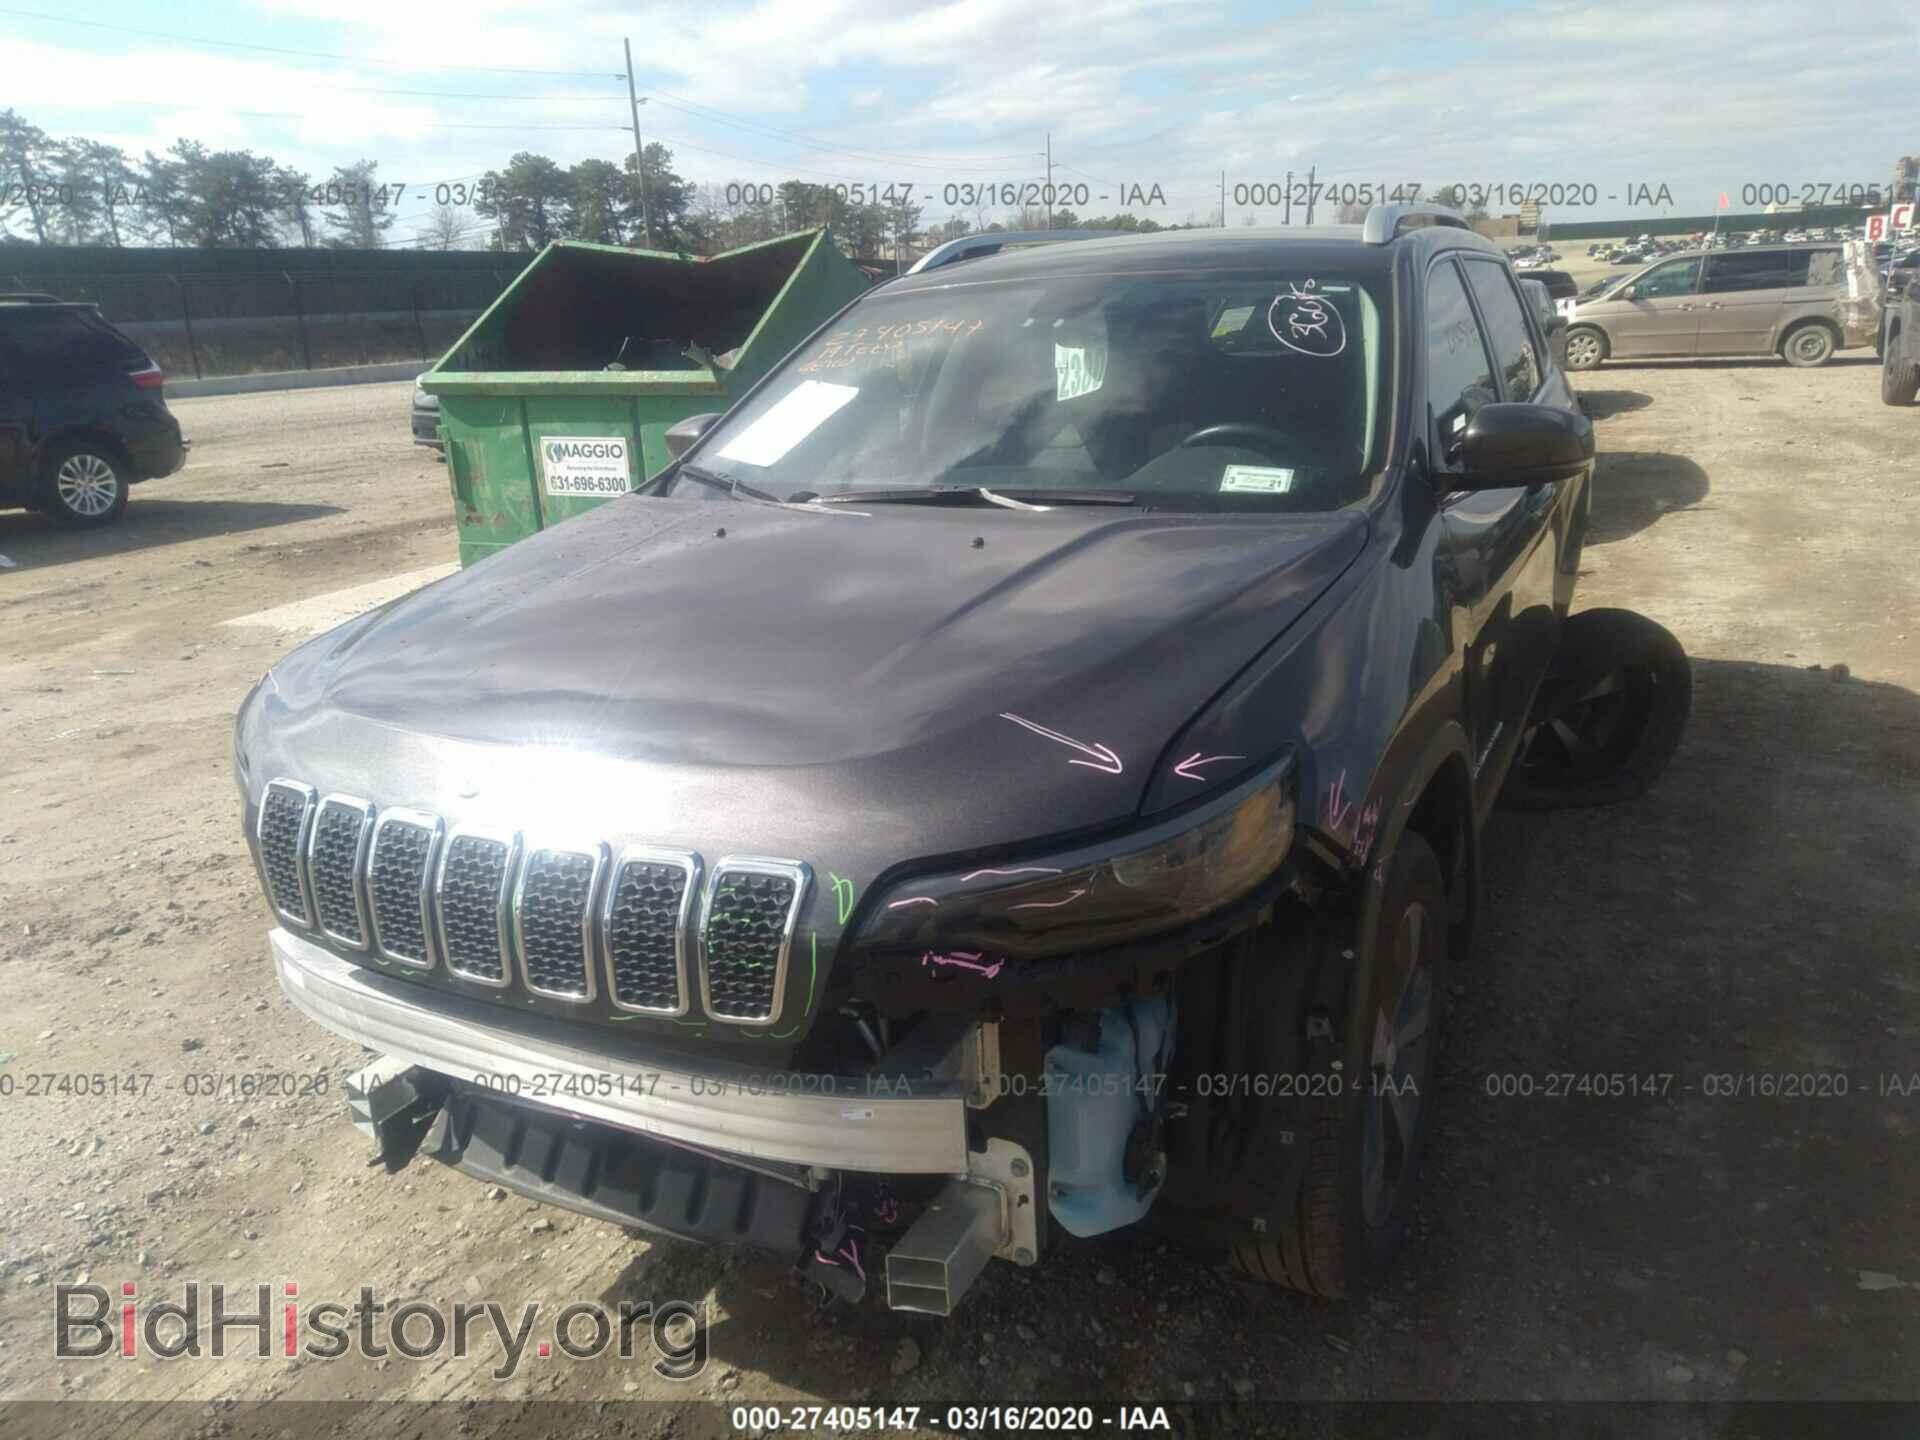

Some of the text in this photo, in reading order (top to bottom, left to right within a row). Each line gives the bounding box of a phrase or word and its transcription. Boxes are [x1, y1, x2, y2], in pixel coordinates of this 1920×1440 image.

[1893, 206, 1911, 229] C
[1868, 216, 1883, 241] B
[560, 443, 623, 458] MAGGIO
[551, 476, 626, 491] 631-696-6300
